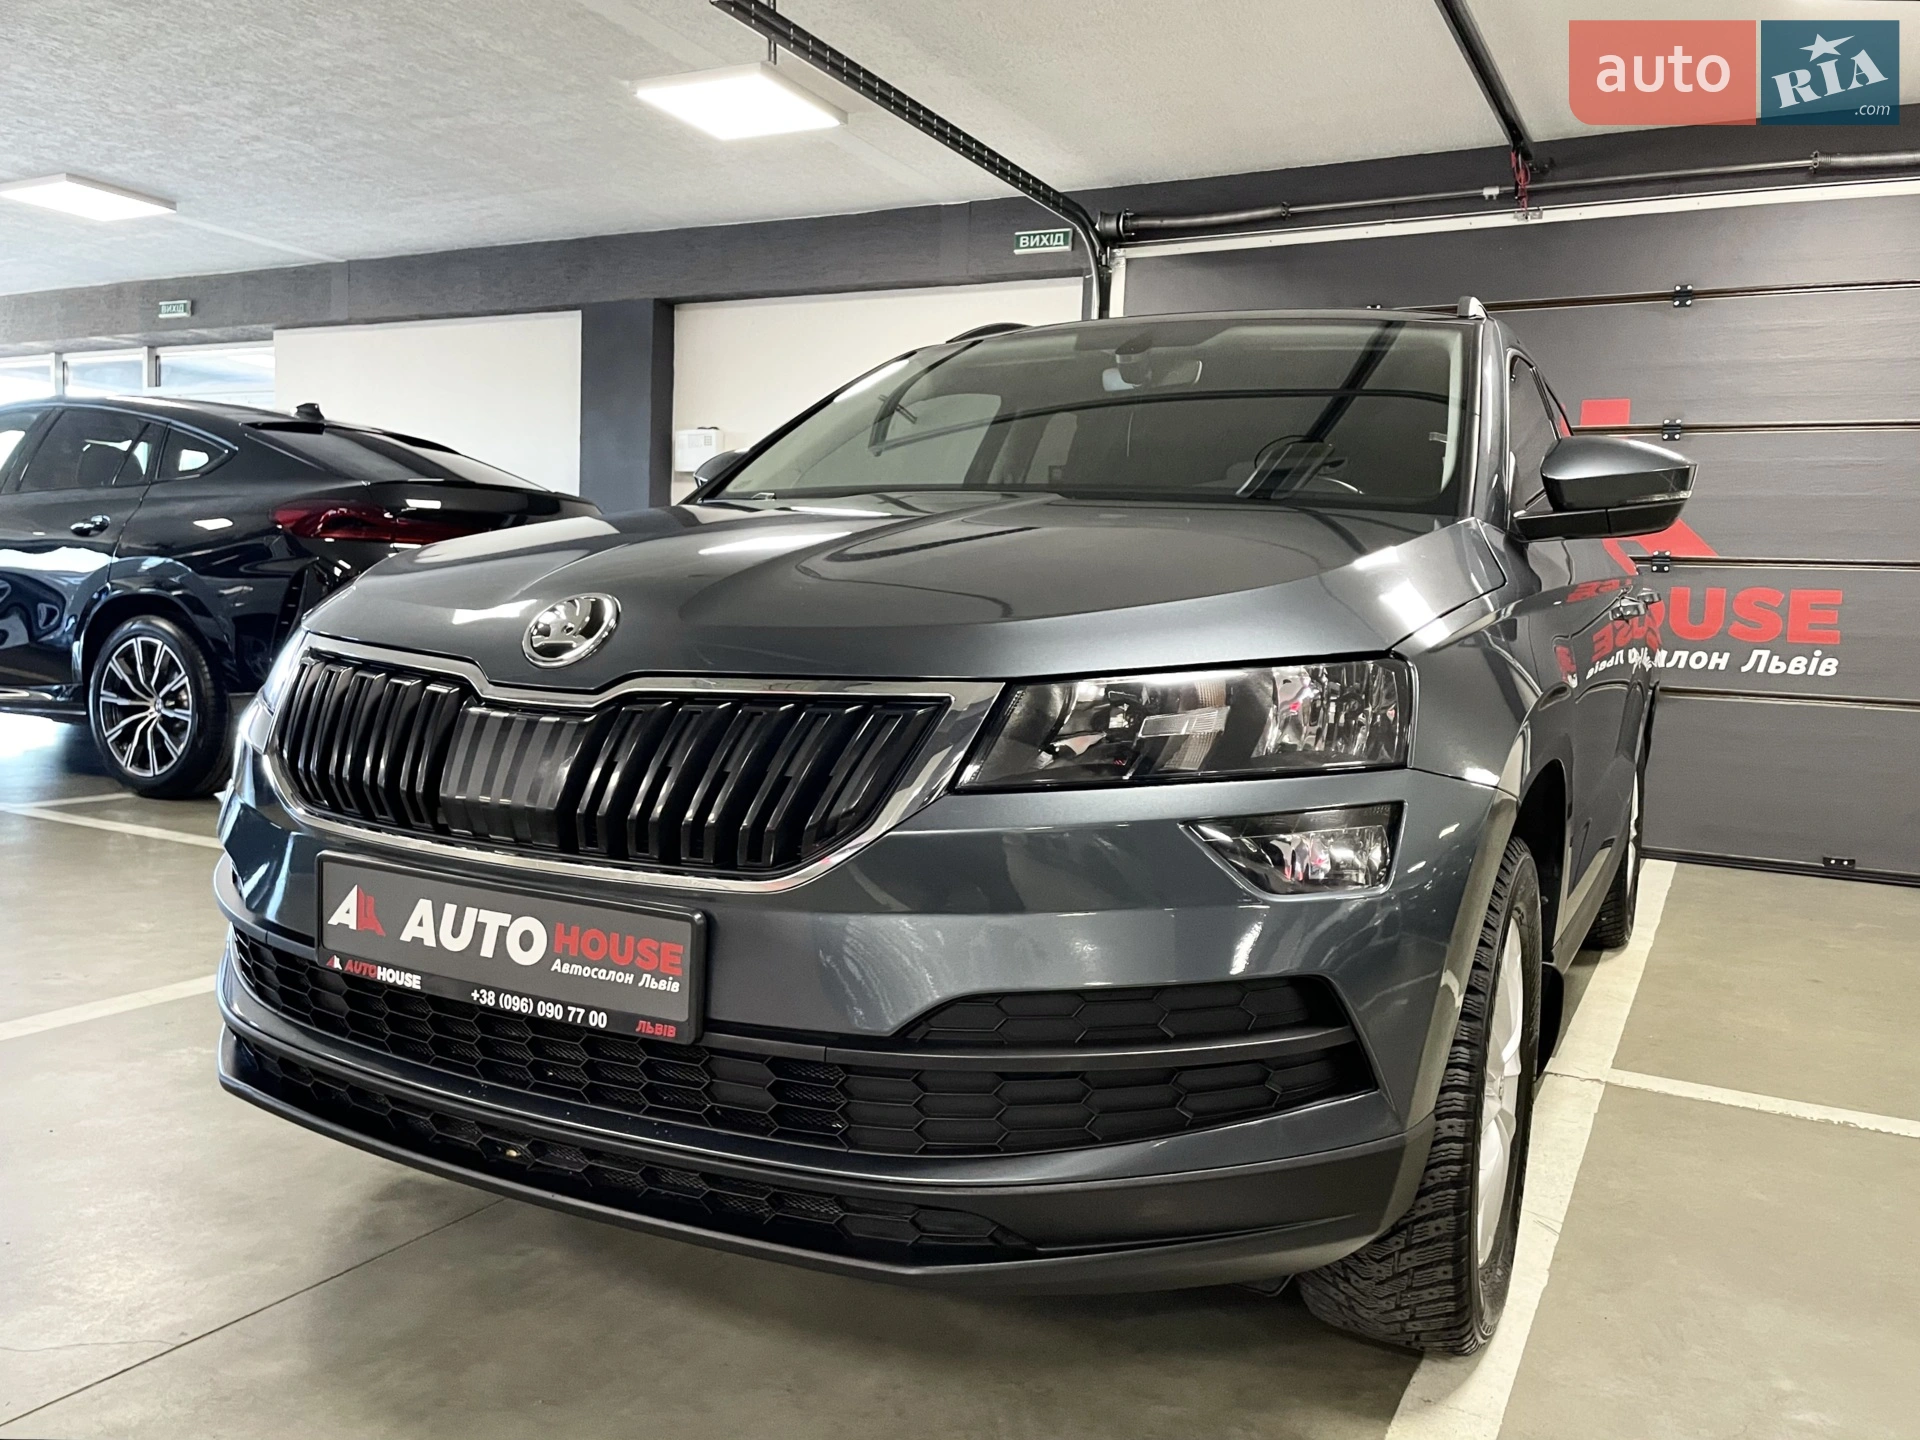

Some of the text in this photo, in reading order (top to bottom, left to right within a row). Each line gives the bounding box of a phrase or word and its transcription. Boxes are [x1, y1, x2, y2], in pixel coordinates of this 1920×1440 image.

[1019, 232, 1065, 248] ВИХІД
[1740, 649, 1839, 677] Львів
[399, 897, 685, 976] AUTO HOUSE
[550, 957, 681, 993] Автосалон Львів
[470, 988, 608, 1029] +38 (096) 090 77 00
[634, 1019, 677, 1039] ЛЬВІВ
